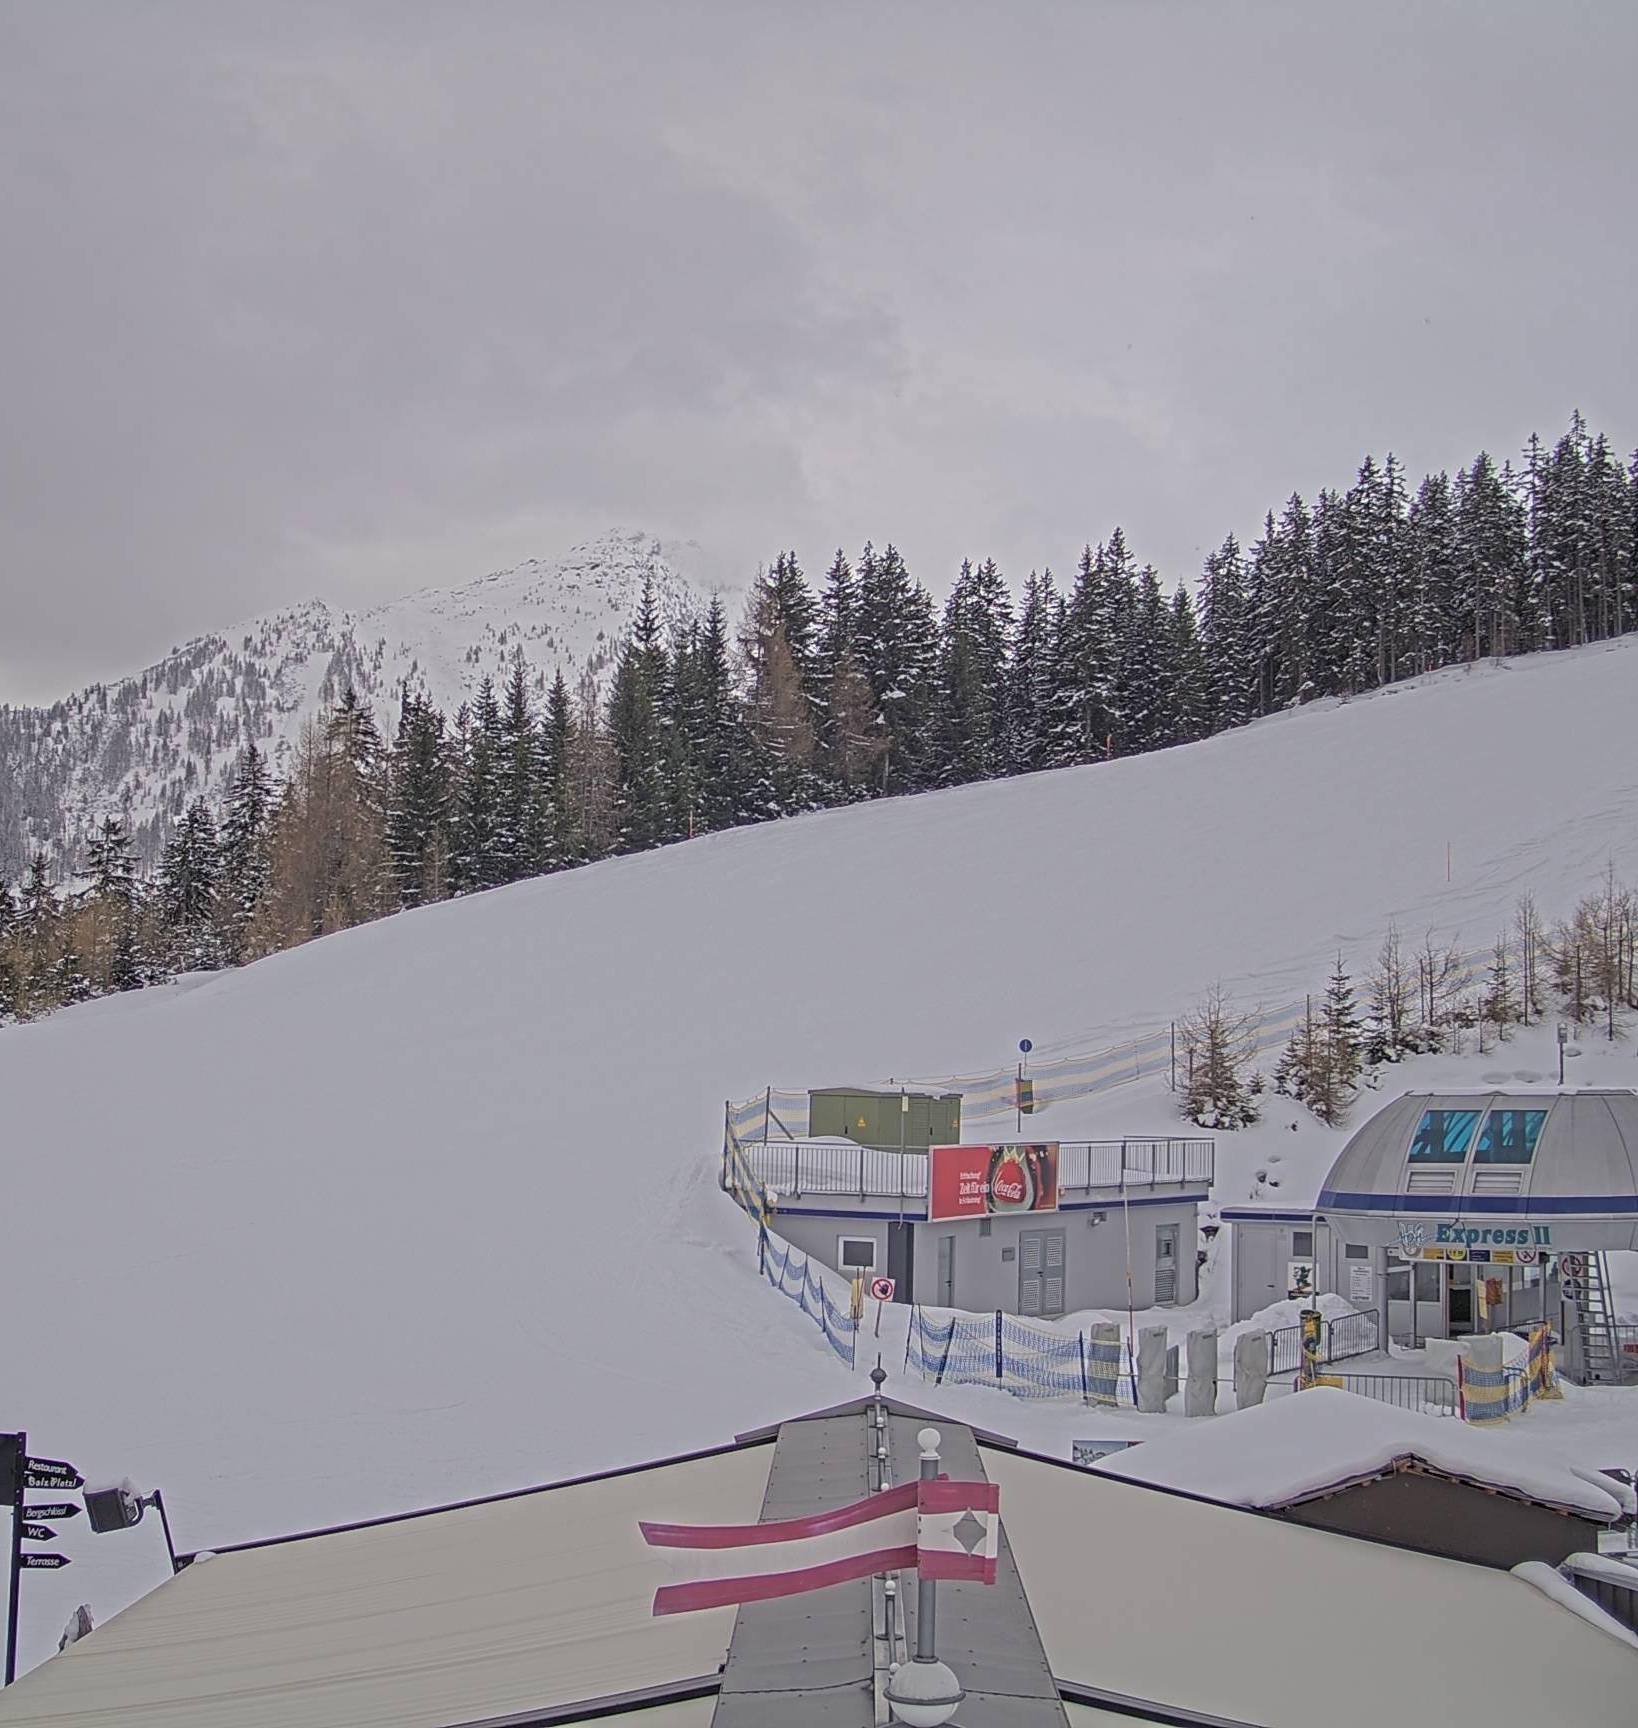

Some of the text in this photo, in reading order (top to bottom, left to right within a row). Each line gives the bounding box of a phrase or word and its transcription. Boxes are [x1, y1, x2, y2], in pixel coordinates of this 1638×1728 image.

[1436, 1223, 1551, 1248] Express II
[28, 1460, 67, 1474] Restaurant
[27, 1527, 46, 1538] WC
[26, 1556, 60, 1566] Terrasse
